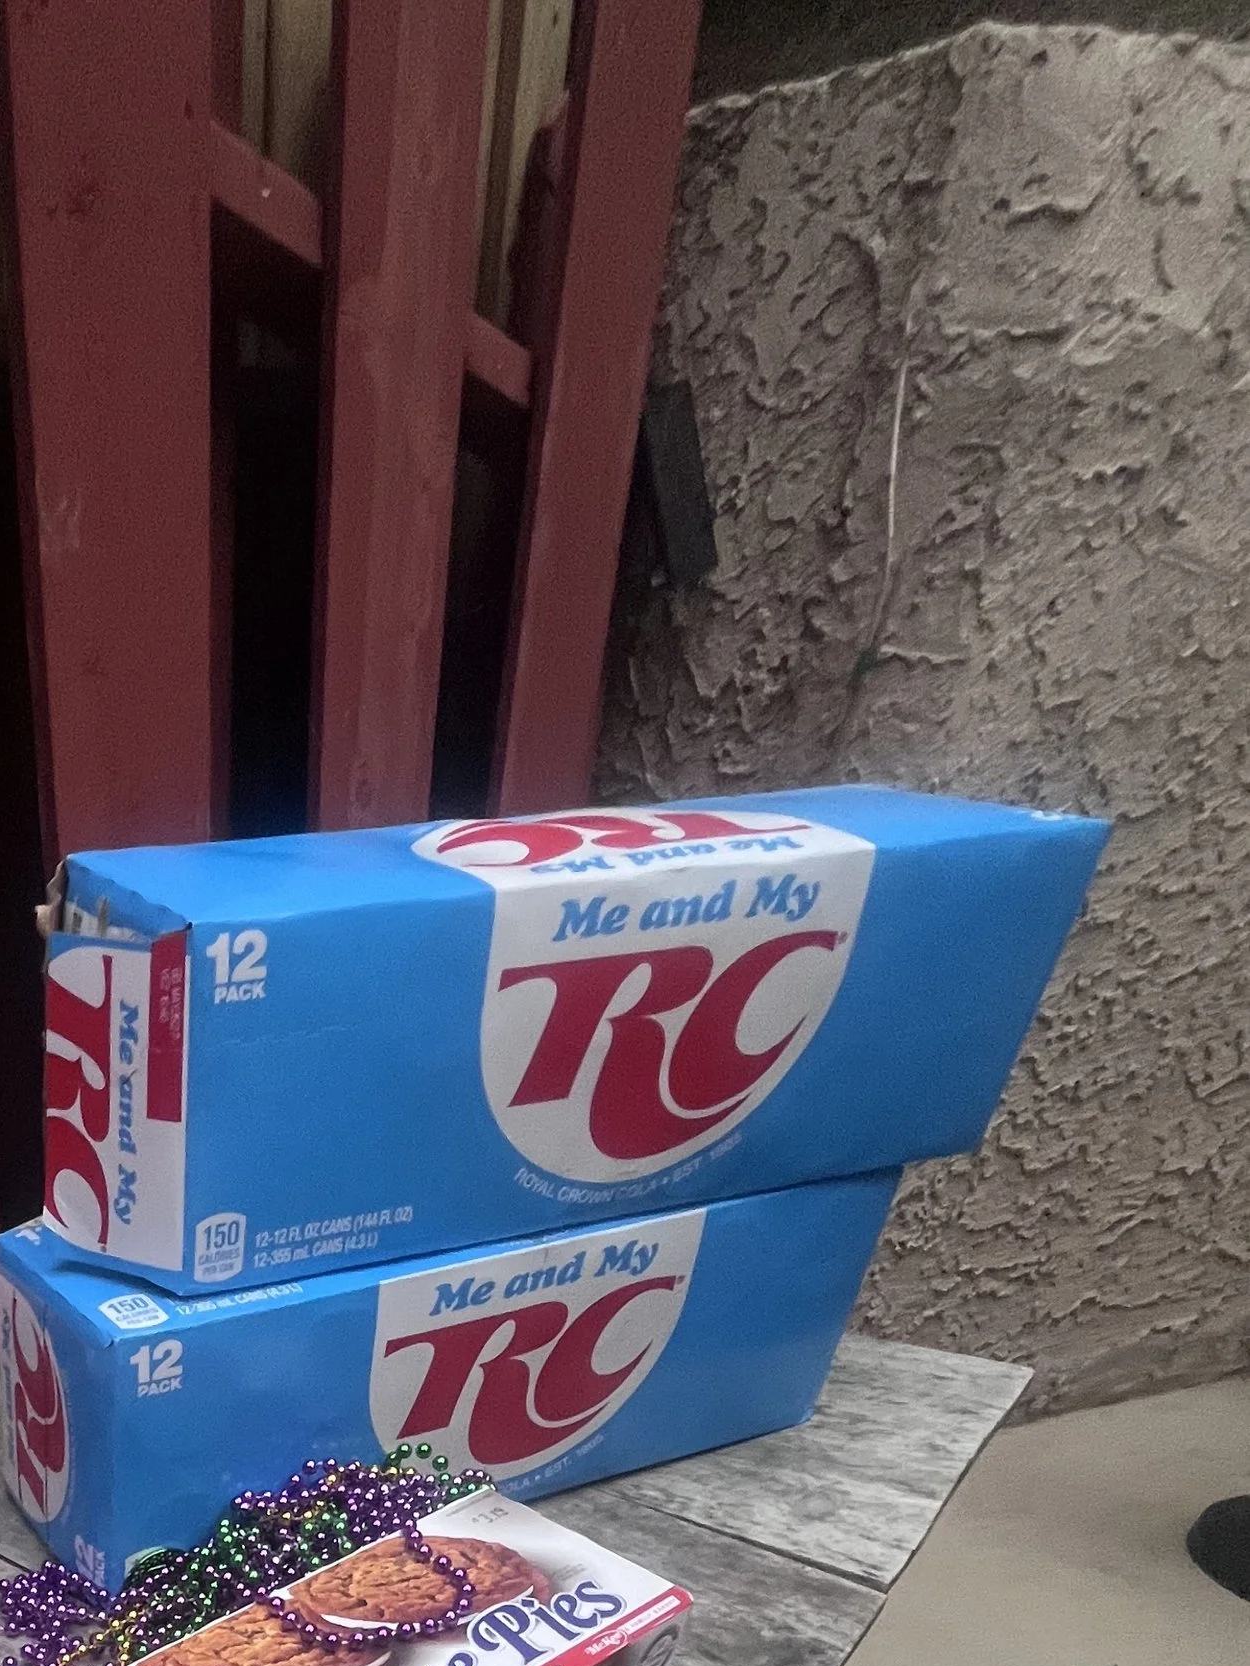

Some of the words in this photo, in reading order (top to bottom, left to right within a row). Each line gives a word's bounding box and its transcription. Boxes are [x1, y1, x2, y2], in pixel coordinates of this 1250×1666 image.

[552, 896, 630, 942] Me
[638, 879, 737, 931] and
[746, 872, 821, 921] My
[206, 929, 268, 984] 12
[214, 980, 266, 1004] PACK
[118, 998, 139, 1066] Me
[498, 930, 836, 1161] RC
[118, 1073, 138, 1155] and
[114, 1163, 138, 1225] My
[557, 1185, 614, 1204] CROWN
[203, 1221, 240, 1251] 150
[254, 1229, 287, 1247] 12-12
[312, 1237, 344, 1257] CANS
[429, 1277, 496, 1316] Me
[503, 1251, 587, 1299] and
[594, 1239, 660, 1276] My
[108, 1297, 150, 1315] 150
[130, 1339, 184, 1384] 12
[137, 1375, 183, 1398] PACK
[383, 1275, 675, 1465] RC
[472, 1580, 623, 1665] Pies
